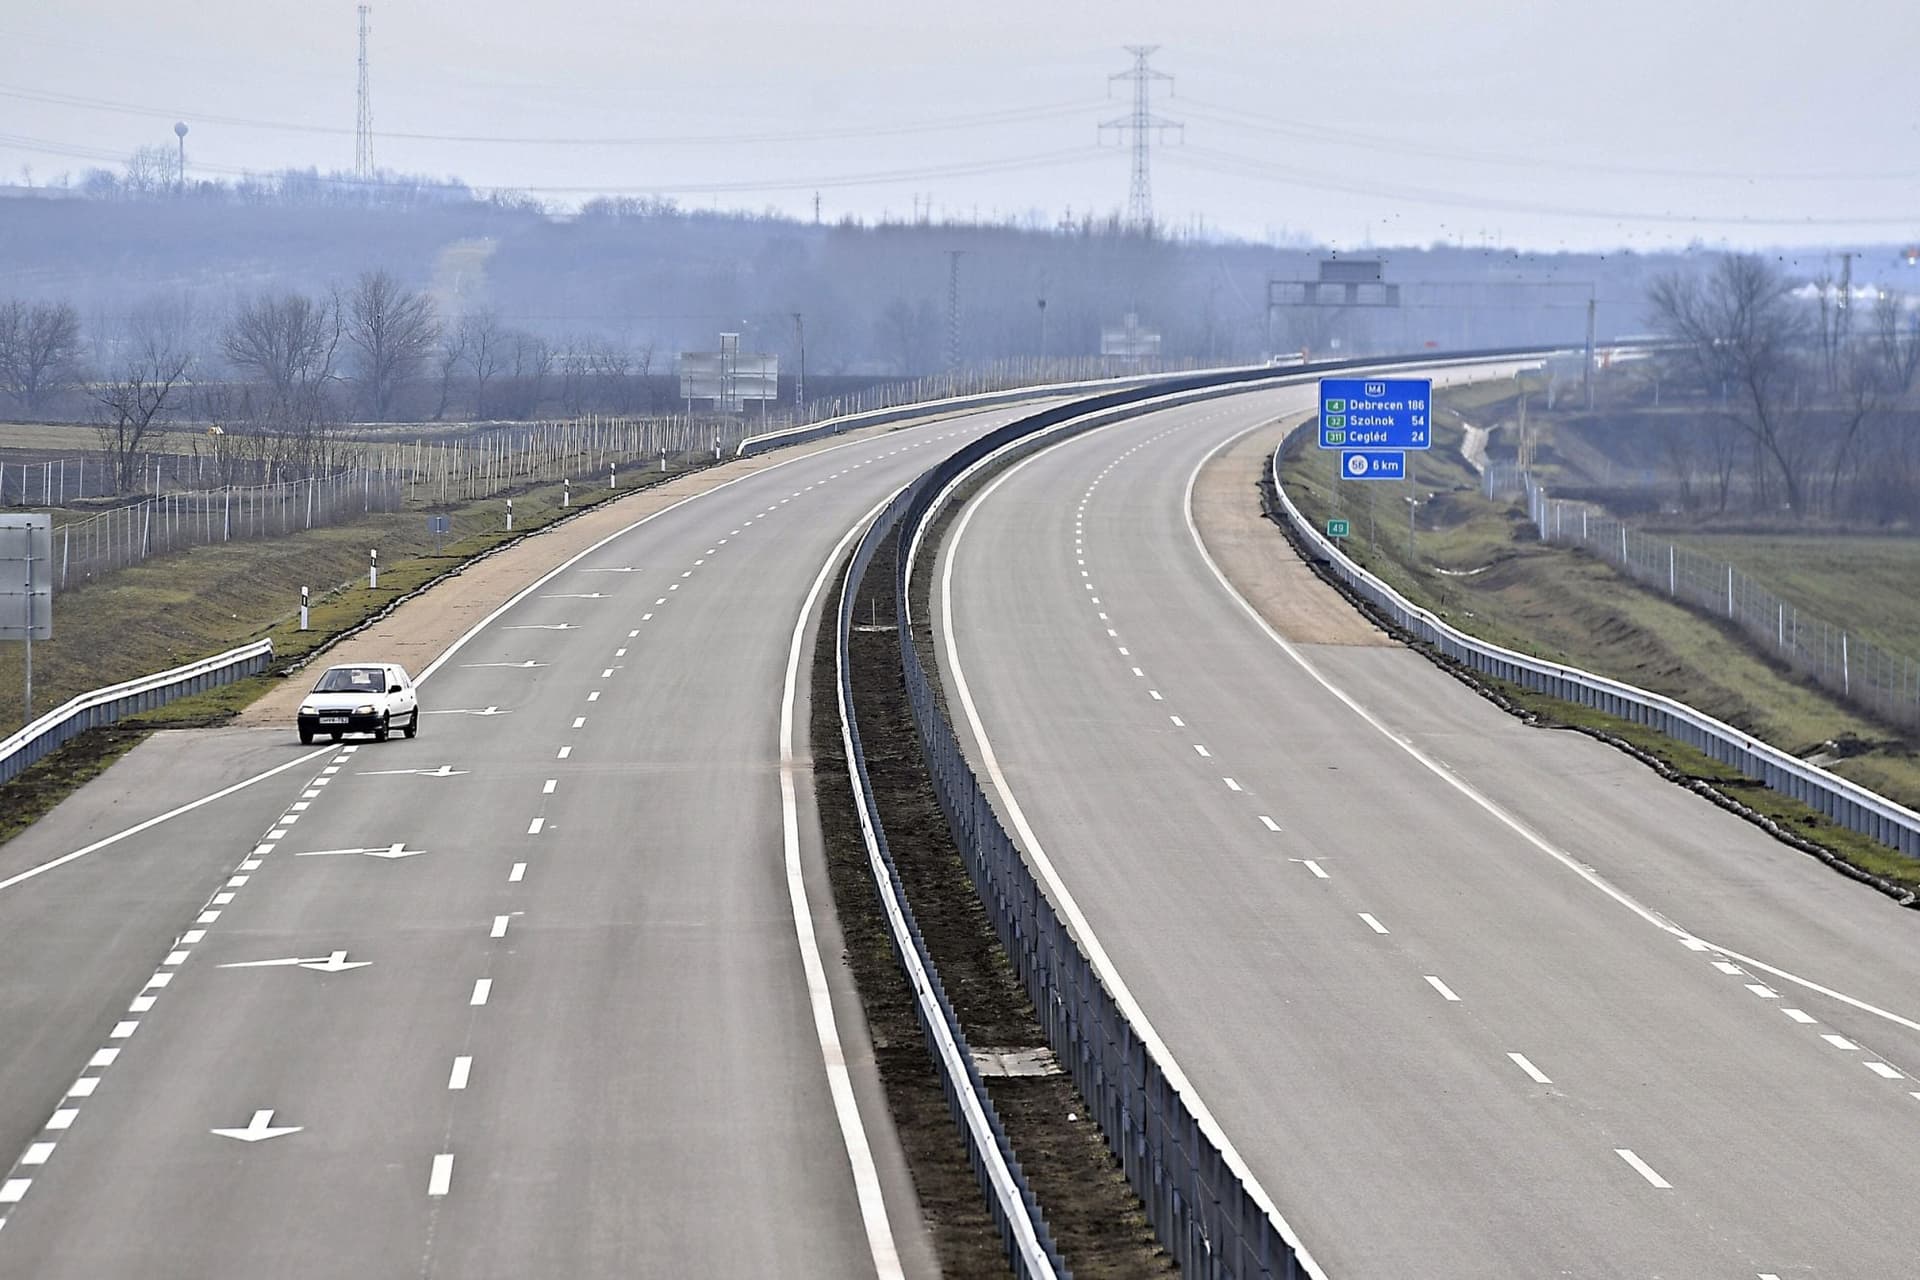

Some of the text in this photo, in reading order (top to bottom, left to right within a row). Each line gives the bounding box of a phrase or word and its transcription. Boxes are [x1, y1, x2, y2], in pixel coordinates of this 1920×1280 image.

[1368, 385, 1382, 394] M4
[1333, 402, 1339, 410] 4
[1350, 400, 1403, 410] Debrecen
[1331, 418, 1341, 426] 32
[1350, 416, 1424, 426] Szolnok 54
[1330, 433, 1342, 441] 311
[1350, 431, 1424, 443] Cegléd 24
[1352, 460, 1364, 470] 56
[1373, 459, 1398, 471] 6 km
